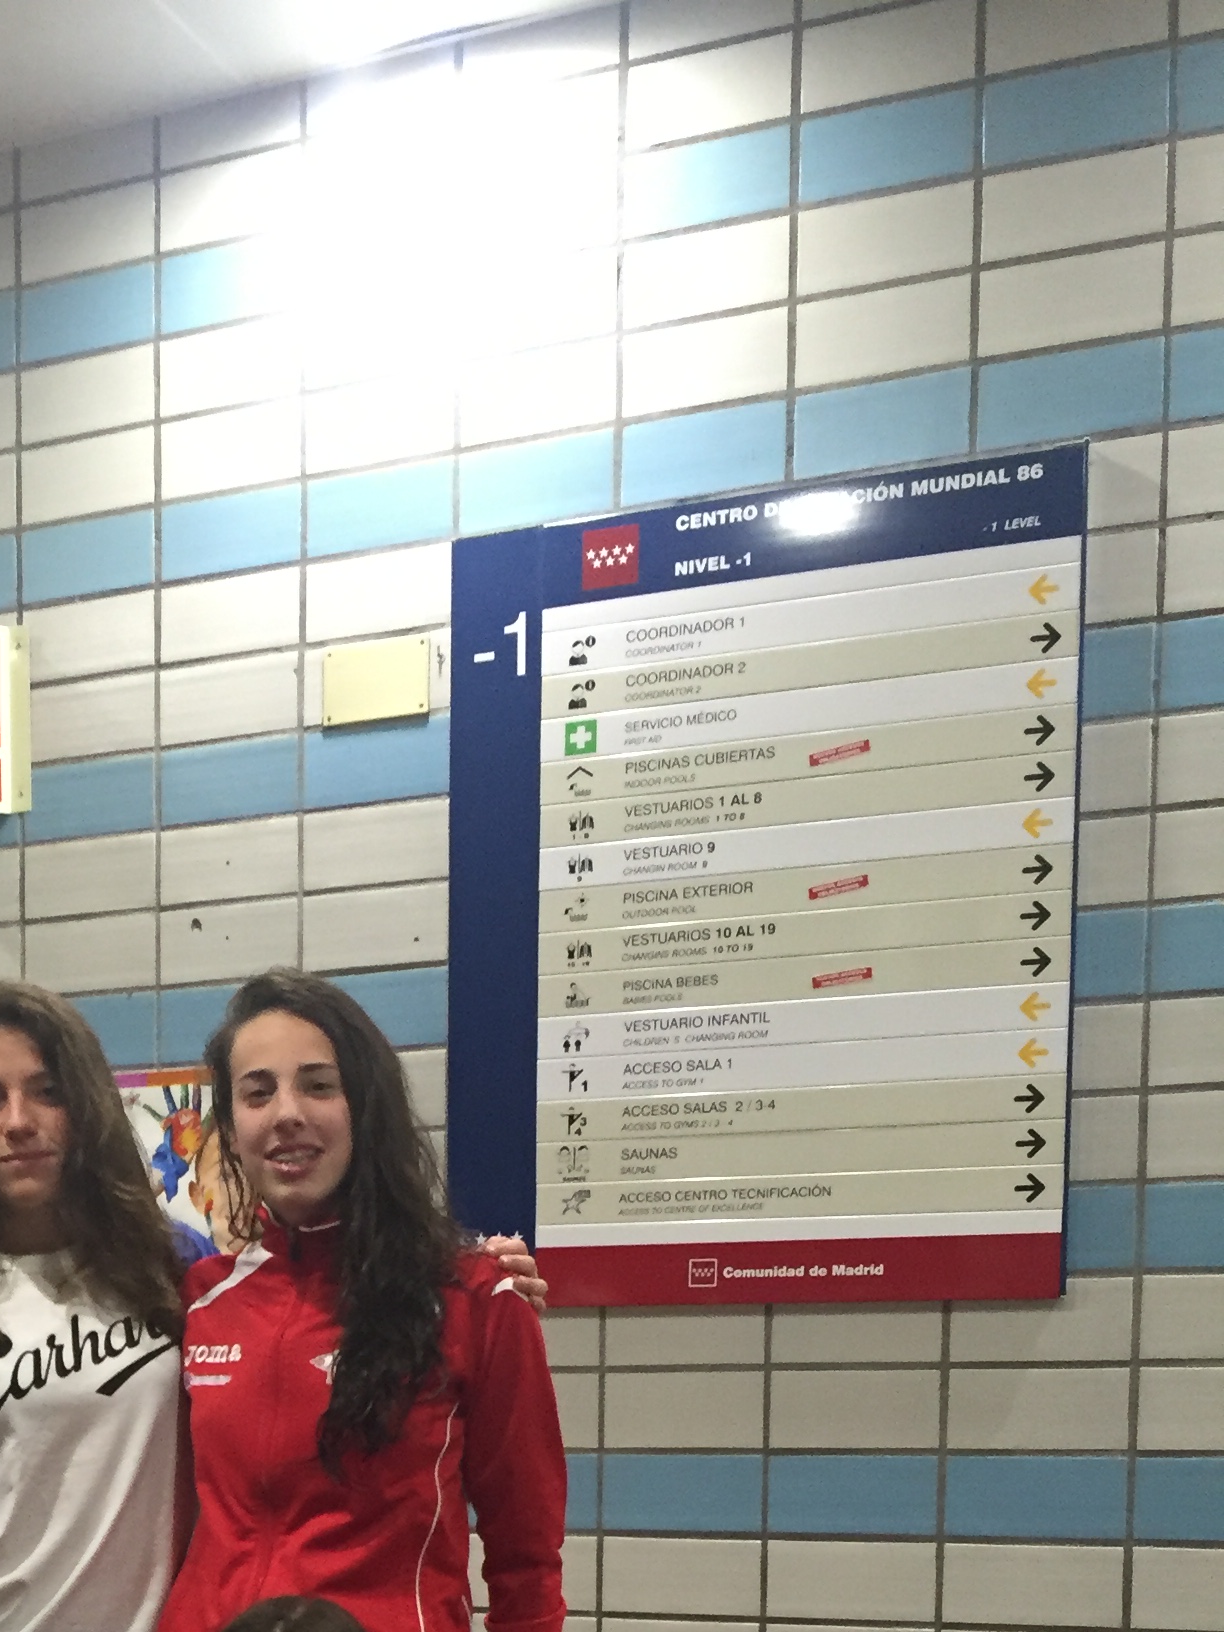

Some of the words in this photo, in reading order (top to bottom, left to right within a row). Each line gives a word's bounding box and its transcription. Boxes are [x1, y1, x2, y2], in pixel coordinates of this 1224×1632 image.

[676, 504, 758, 532] CENTRO
[910, 469, 1010, 496] MUNDIAL
[1017, 463, 1044, 481] 86
[1004, 515, 1041, 531] LEVEL
[675, 556, 730, 576] NIVEL
[736, 552, 752, 568] -1
[625, 617, 734, 643] COORDINADOR
[739, 616, 745, 628] 1
[474, 611, 526, 676] -1
[625, 641, 694, 658] COORDINATOR
[625, 663, 733, 687] COORDINADOR
[738, 661, 747, 673] 2
[625, 686, 694, 702] COORDINATOR
[624, 715, 682, 733] SERVICIO
[686, 708, 737, 727] MÉDICO
[625, 755, 690, 774] PISCINAS
[694, 746, 775, 767] CUBIERTAS
[625, 797, 713, 818] VESTUARIOS
[719, 796, 724, 807] 1
[730, 794, 749, 807] AL
[754, 792, 762, 804] 8
[724, 813, 736, 821] TO
[624, 842, 703, 861] VESTUARIO
[707, 841, 716, 853] 9
[667, 861, 697, 872] ROOM
[623, 888, 678, 905] PISCINA
[682, 881, 753, 899] EXTERIOR
[622, 908, 668, 919] OUTDOOR
[622, 928, 711, 947] VESTUARIOS
[716, 927, 732, 939] 10
[735, 925, 755, 937] AL
[760, 923, 776, 936] 19
[726, 944, 739, 953] TO
[622, 977, 673, 991] PISCINA
[676, 974, 719, 988] BEBES
[624, 1015, 704, 1033] VESTUARIO
[707, 1011, 771, 1028] INFANTIL
[737, 1029, 769, 1040] ROOM
[623, 1060, 682, 1076] ACCESO
[686, 1058, 723, 1072] SALA
[727, 1058, 732, 1069] 1
[622, 1079, 659, 1090] ACCESS
[661, 1078, 674, 1088] TO
[676, 1077, 697, 1087] GYM
[622, 1103, 680, 1117] ACCESO
[683, 1101, 727, 1114] SALAS
[735, 1100, 744, 1112] 2
[621, 1121, 657, 1132] ACCESS
[659, 1121, 671, 1130] TO
[621, 1147, 678, 1161] SAUNAS
[618, 1190, 672, 1203] ACCESO
[675, 1189, 728, 1201] CENTRO
[732, 1183, 832, 1199] TECNIFICACIÓN
[723, 1265, 805, 1278] Comunidad
[809, 1265, 828, 1277] de
[832, 1263, 884, 1276] Madrid
